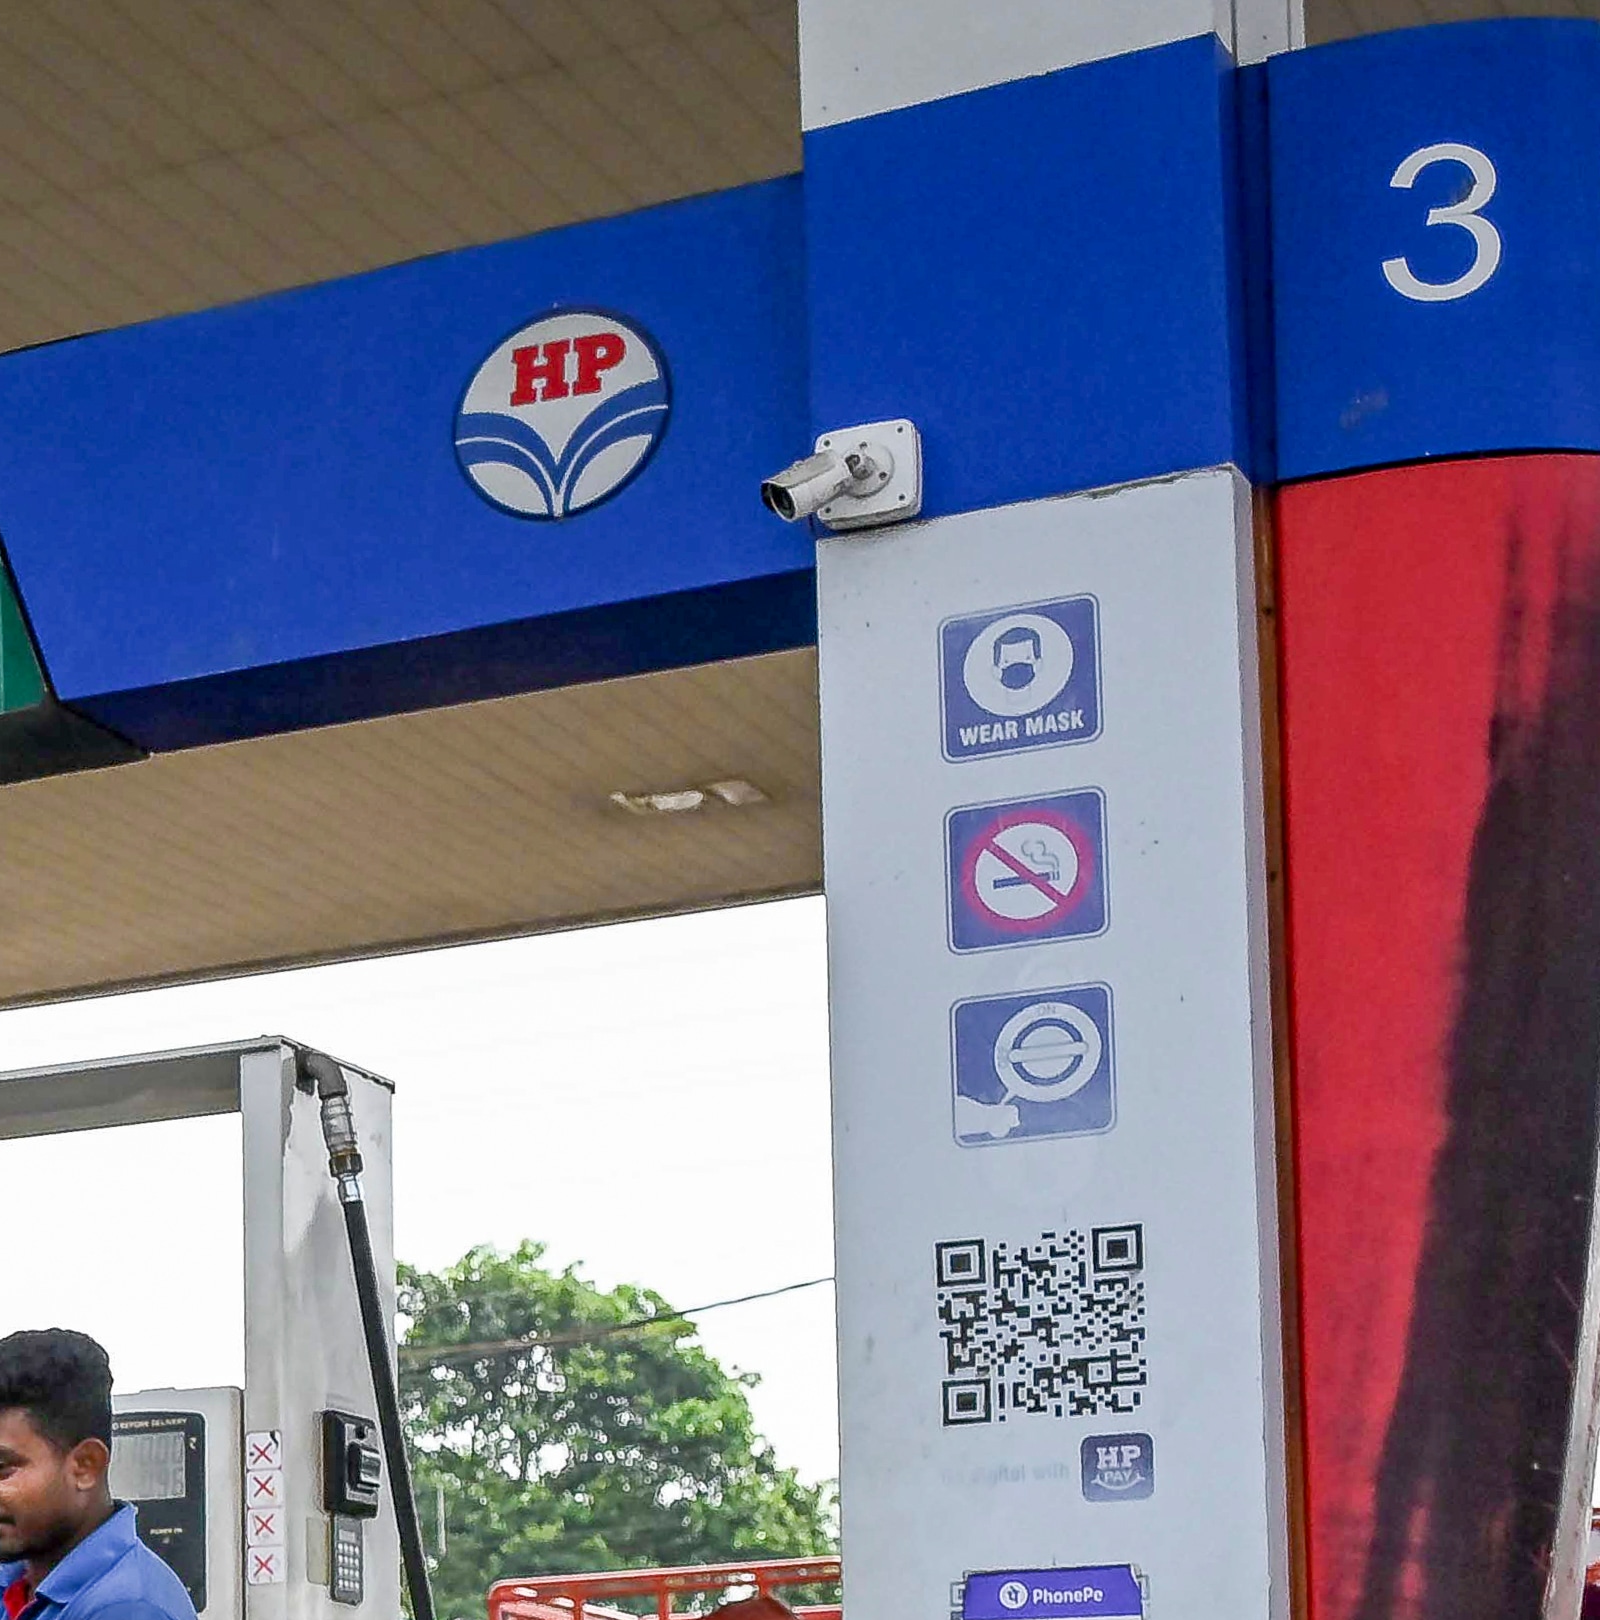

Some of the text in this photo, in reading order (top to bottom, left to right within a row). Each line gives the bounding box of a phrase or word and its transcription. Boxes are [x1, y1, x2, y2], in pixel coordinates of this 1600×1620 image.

[1382, 142, 1501, 302] 3
[508, 330, 627, 408] HP
[958, 708, 1085, 749] WEAR MASK
[1095, 1445, 1142, 1469] HP
[1103, 1470, 1132, 1484] PAY
[1032, 1586, 1104, 1605] PhonePe
